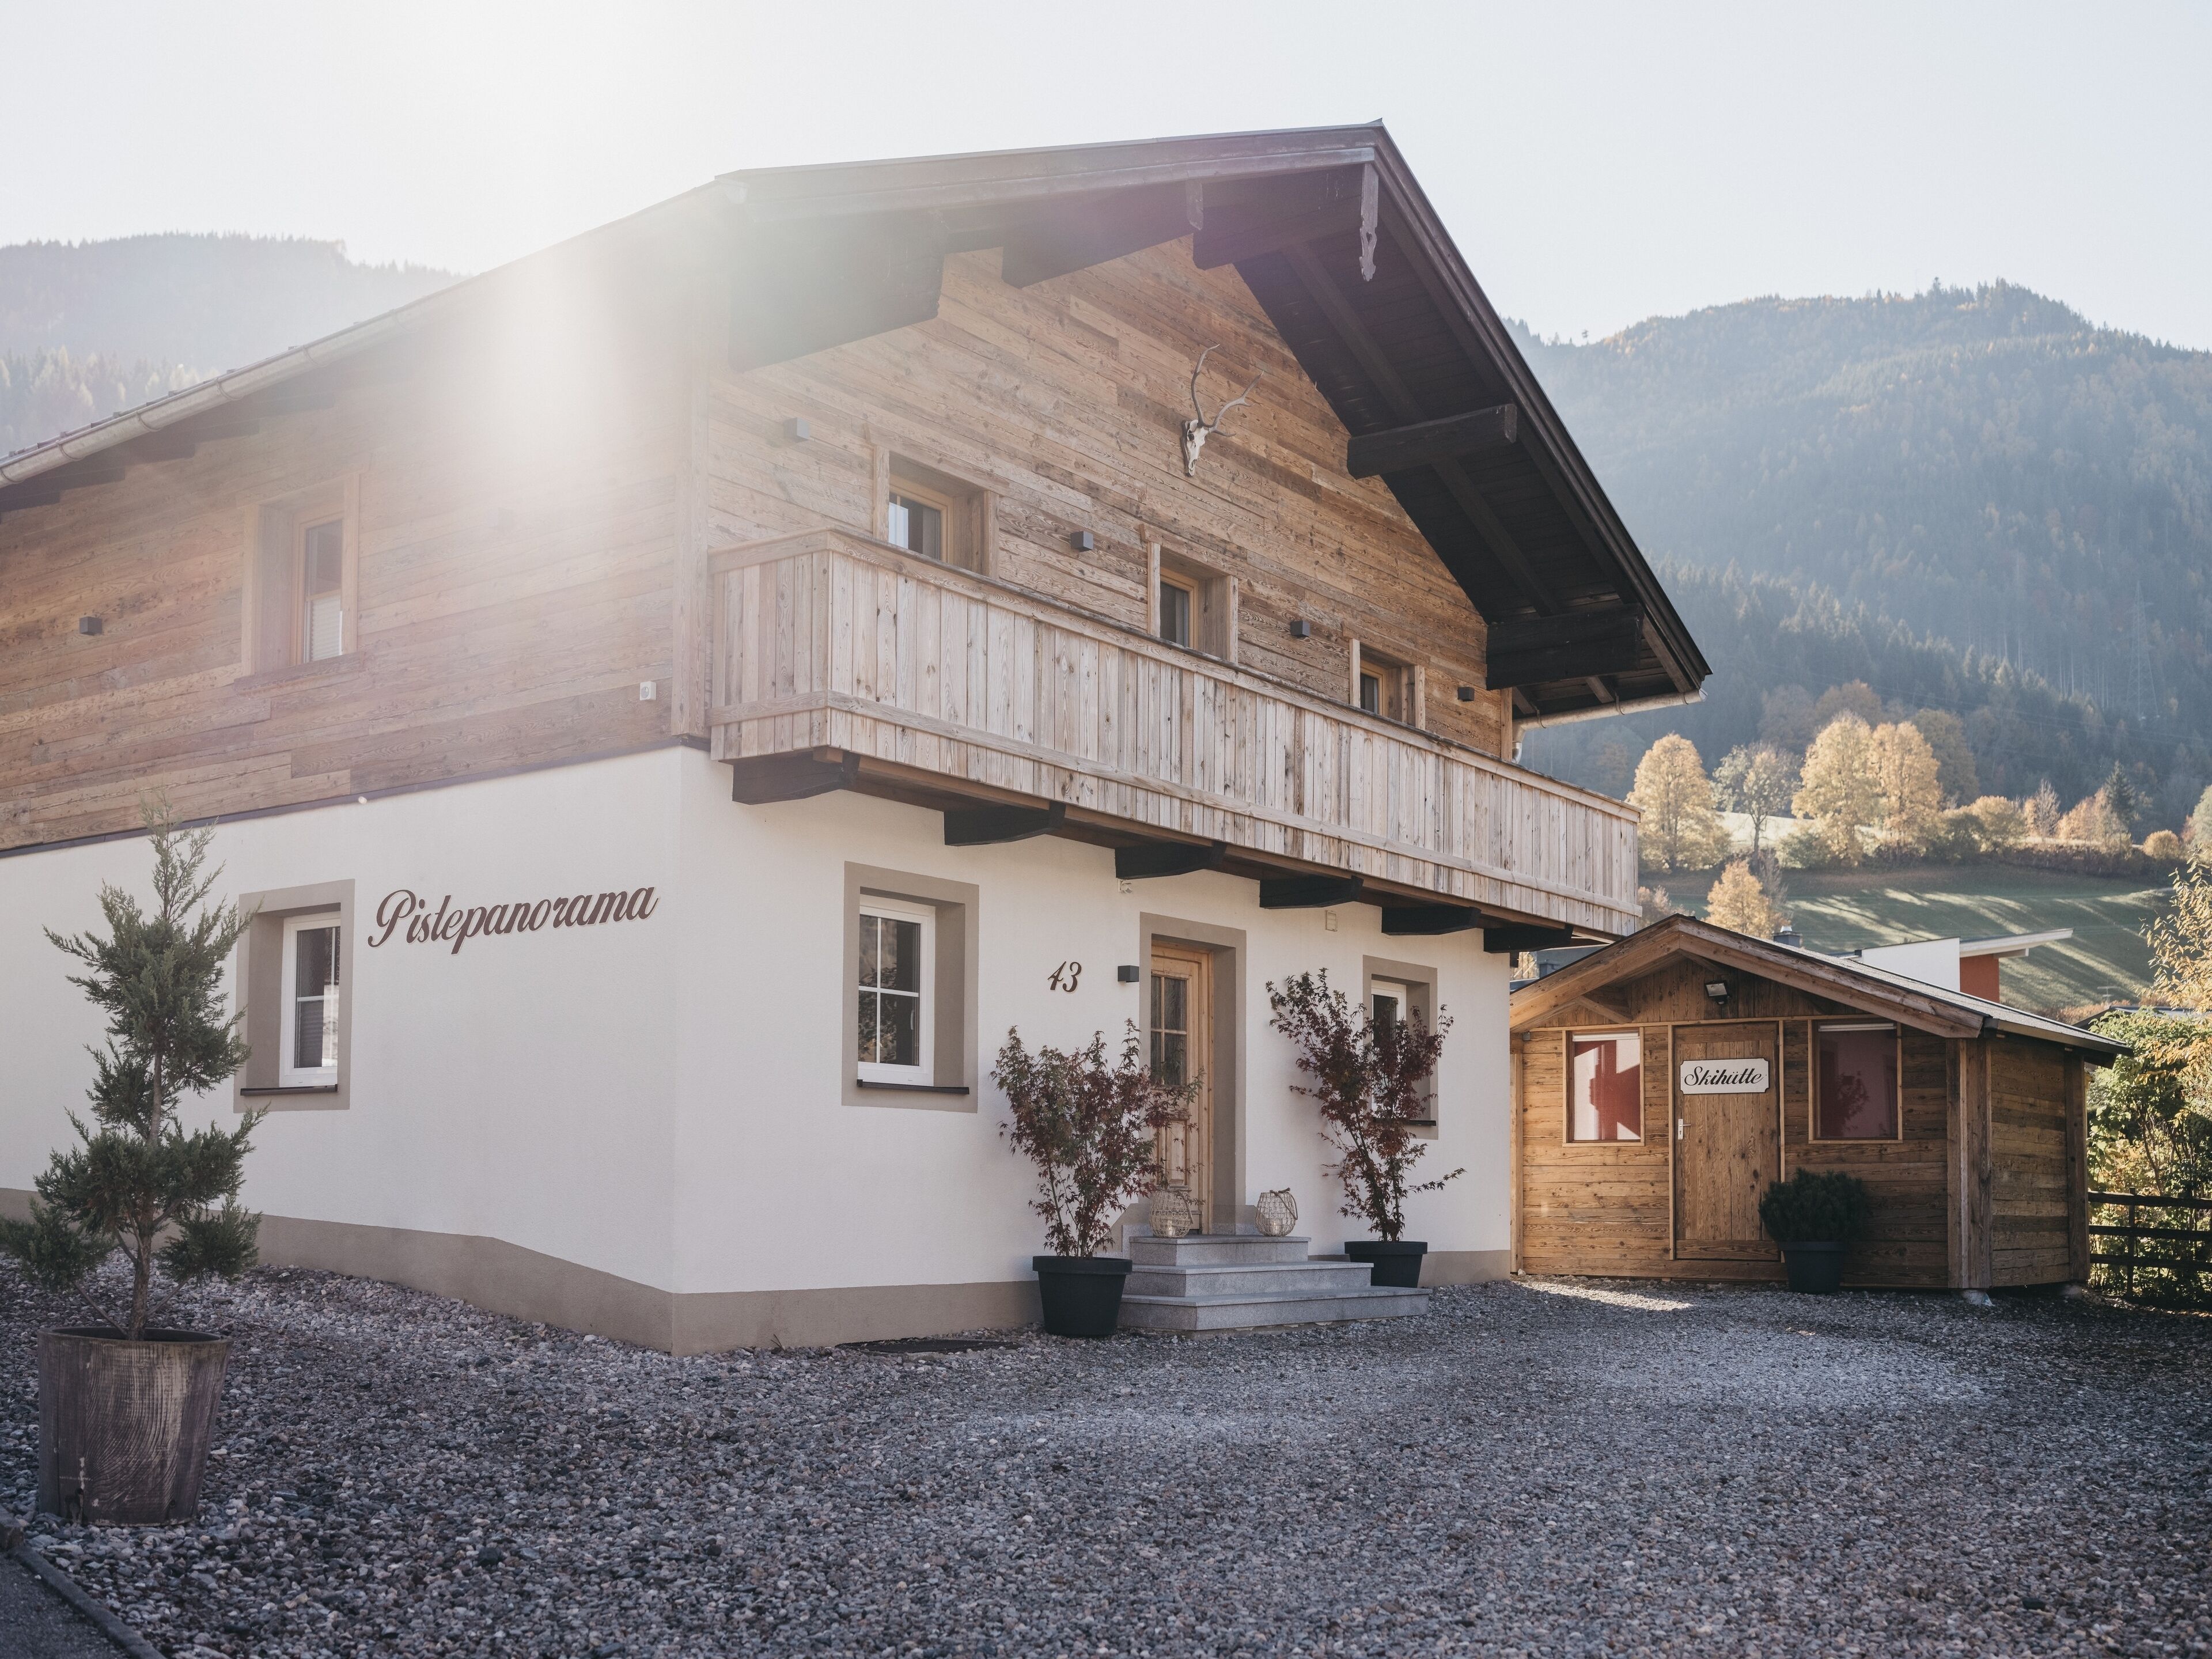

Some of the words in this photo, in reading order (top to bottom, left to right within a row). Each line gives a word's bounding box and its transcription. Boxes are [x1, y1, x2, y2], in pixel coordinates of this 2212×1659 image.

[368, 886, 660, 955] Pistepanorama
[1047, 961, 1082, 993] 43
[1684, 1066, 1764, 1086] Skihütte
